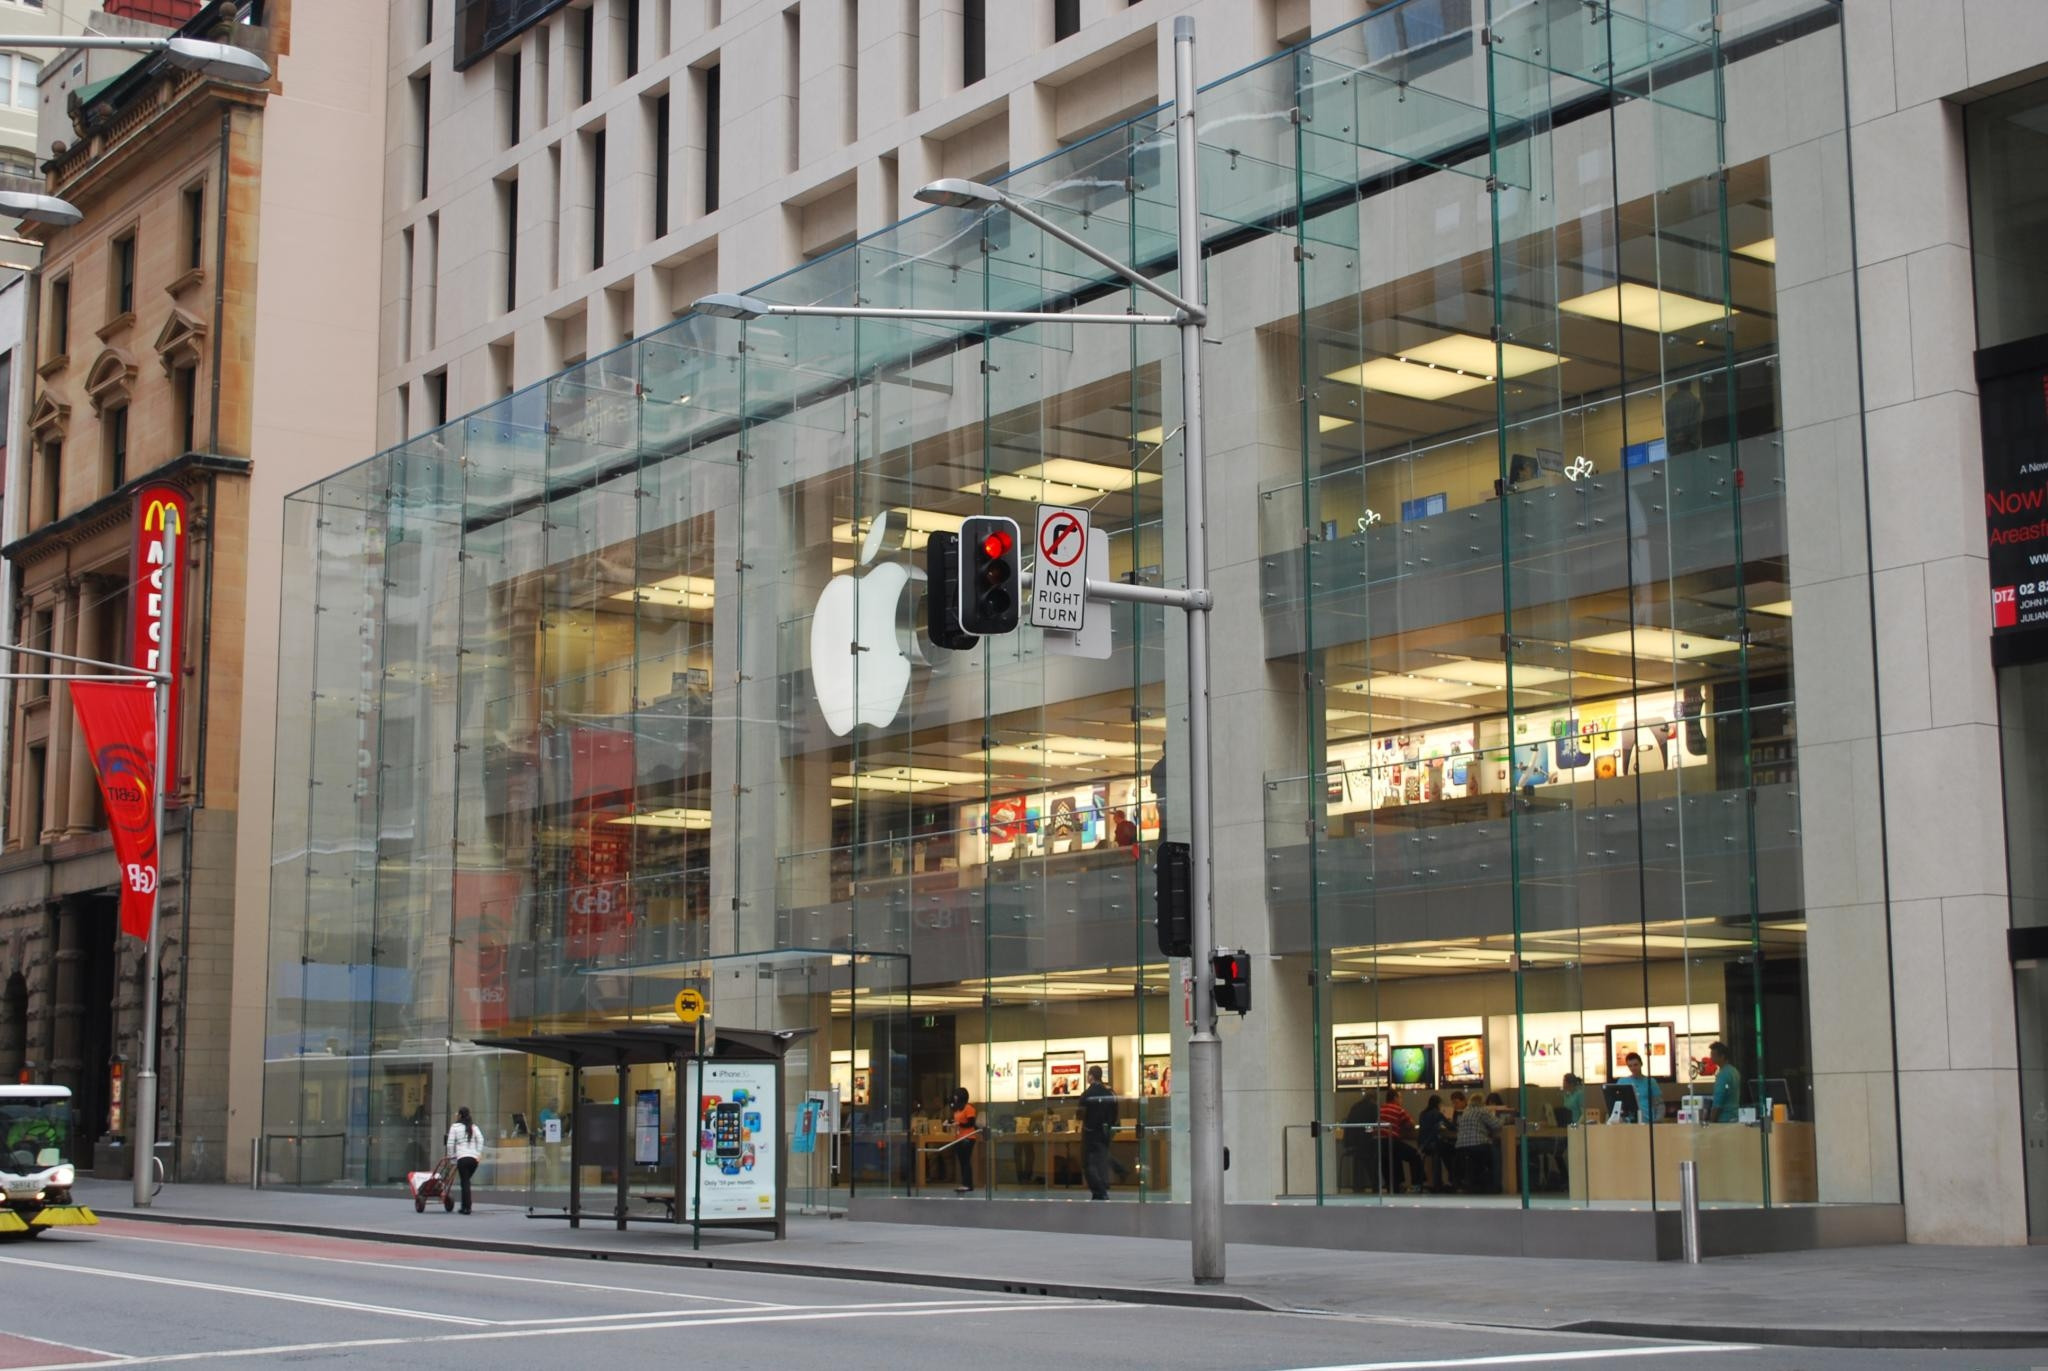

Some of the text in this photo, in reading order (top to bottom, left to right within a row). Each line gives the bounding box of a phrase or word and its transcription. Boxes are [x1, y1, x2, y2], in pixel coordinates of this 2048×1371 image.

[2020, 464, 2027, 474] A
[1986, 488, 2043, 518] Now
[1046, 570, 1072, 588] NO
[1995, 588, 2015, 603] DTZ
[2019, 583, 2035, 595] 02
[1040, 590, 1080, 605] RIGHT
[2020, 599, 2042, 609] JOHN
[1040, 607, 1077, 622] TURN
[1524, 1037, 1563, 1057] Work
